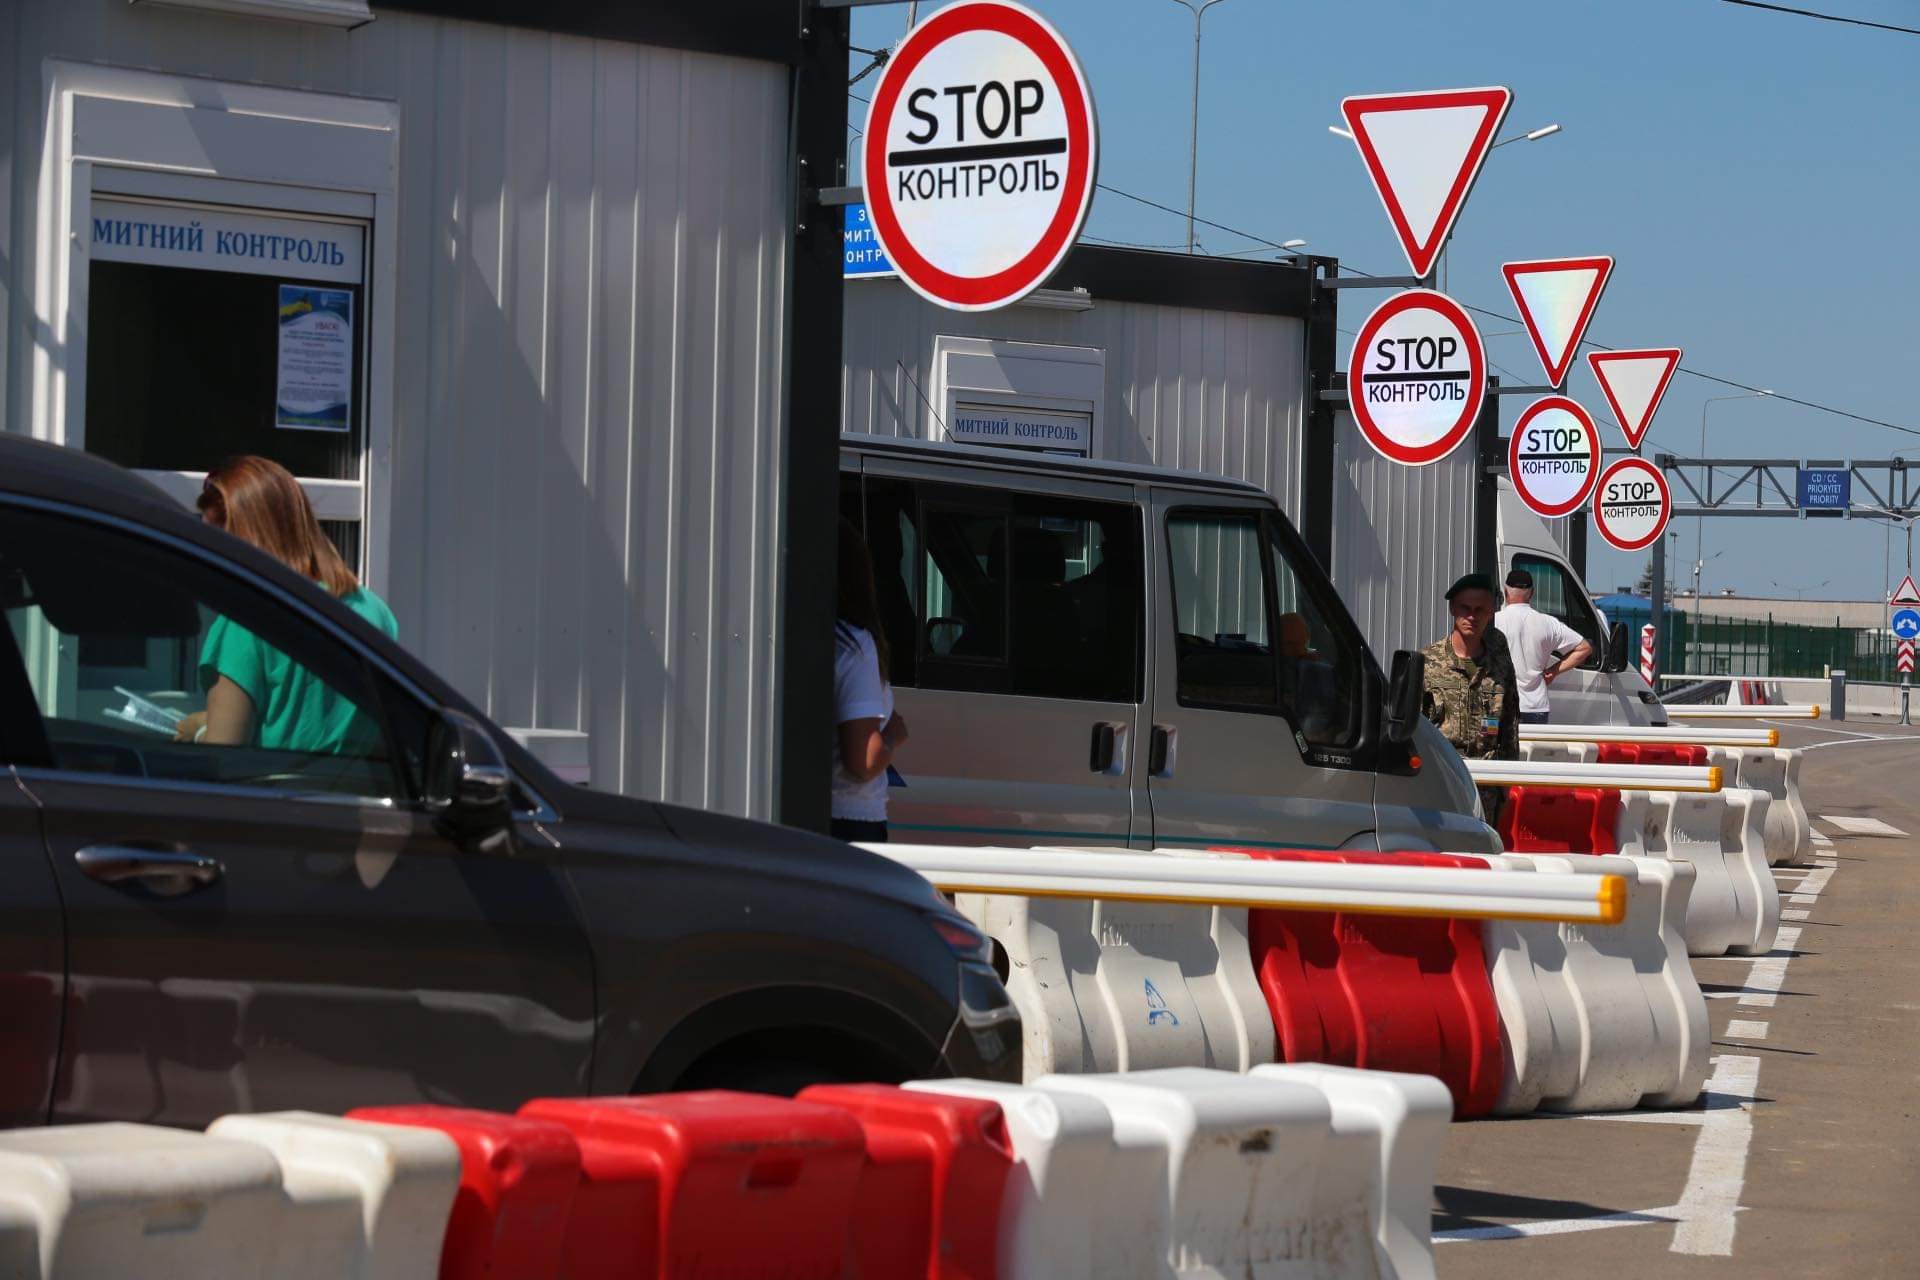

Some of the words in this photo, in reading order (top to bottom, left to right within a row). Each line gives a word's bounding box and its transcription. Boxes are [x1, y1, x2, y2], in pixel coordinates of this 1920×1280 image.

[906, 79, 1044, 145] STOP
[898, 159, 1060, 202] КОНТРОЛЬ
[92, 216, 204, 252] МИТНИЙ
[216, 230, 344, 266] КОНТРОЛЬ
[1375, 336, 1457, 372] STOP
[1369, 381, 1466, 403] КОНТРОЛЬ
[955, 417, 1009, 436] МИТНИЙ
[1014, 422, 1078, 441] КОНТРОЛЬ
[1527, 428, 1582, 453] STOP
[1522, 460, 1587, 475] КОНТРОЛЬ
[1608, 482, 1655, 501] STOP
[1807, 484, 1841, 494] PRIORYTET
[1809, 494, 1839, 504] PRIORITY
[1603, 506, 1659, 519] КОНТРОЛЬ
